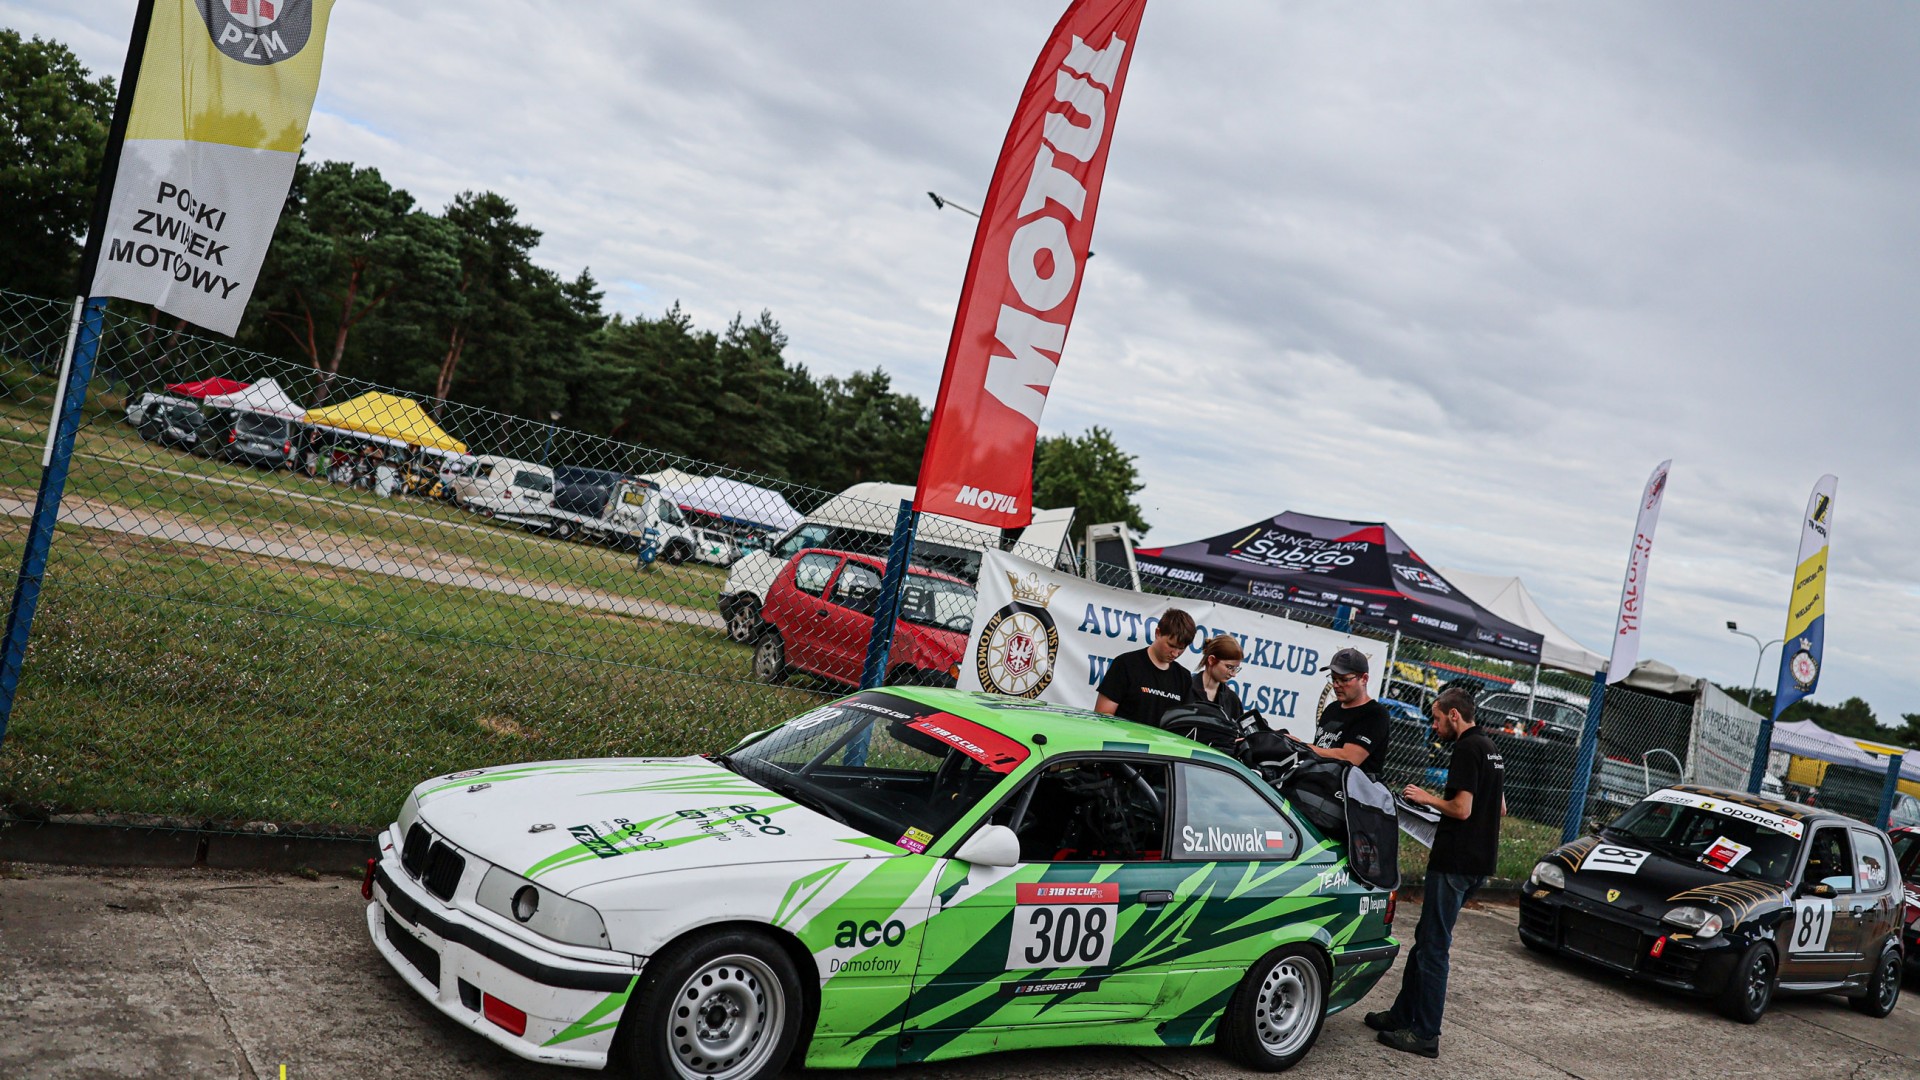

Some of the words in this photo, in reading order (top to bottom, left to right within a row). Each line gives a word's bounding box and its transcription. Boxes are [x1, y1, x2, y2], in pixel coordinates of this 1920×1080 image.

[218, 22, 289, 60] PZM
[983, 31, 1126, 428] MOTUL
[108, 237, 240, 300] MOTOWY
[954, 484, 1019, 515] MOTUL
[1246, 539, 1355, 566] SubiGo
[1264, 529, 1369, 553] KANCELARIA
[1135, 560, 1168, 576] YMON
[1252, 585, 1285, 600] SubiGo
[977, 611, 1003, 696] AUTOMOBILK
[1078, 602, 1320, 677] AUTOOLKLUB
[1088, 653, 1300, 719] WOLSKI
[929, 726, 952, 737] 318
[947, 734, 963, 744] IS
[959, 740, 985, 755] CUP
[729, 805, 786, 836] aco
[1182, 825, 1265, 852] Sz.Nowak
[1593, 847, 1644, 868] 81
[1048, 887, 1065, 896] 318
[1066, 887, 1077, 896] IS
[1076, 887, 1098, 896] CUP
[1317, 871, 1350, 894] TEAM
[1370, 895, 1387, 914] heymo
[834, 919, 906, 949] aco
[1024, 906, 1107, 965] 308
[1797, 903, 1825, 948] 81
[829, 956, 902, 975] Domofony
[1025, 985, 1034, 993] 3
[1033, 983, 1068, 993] SERIES
[1067, 981, 1087, 991] CUP
